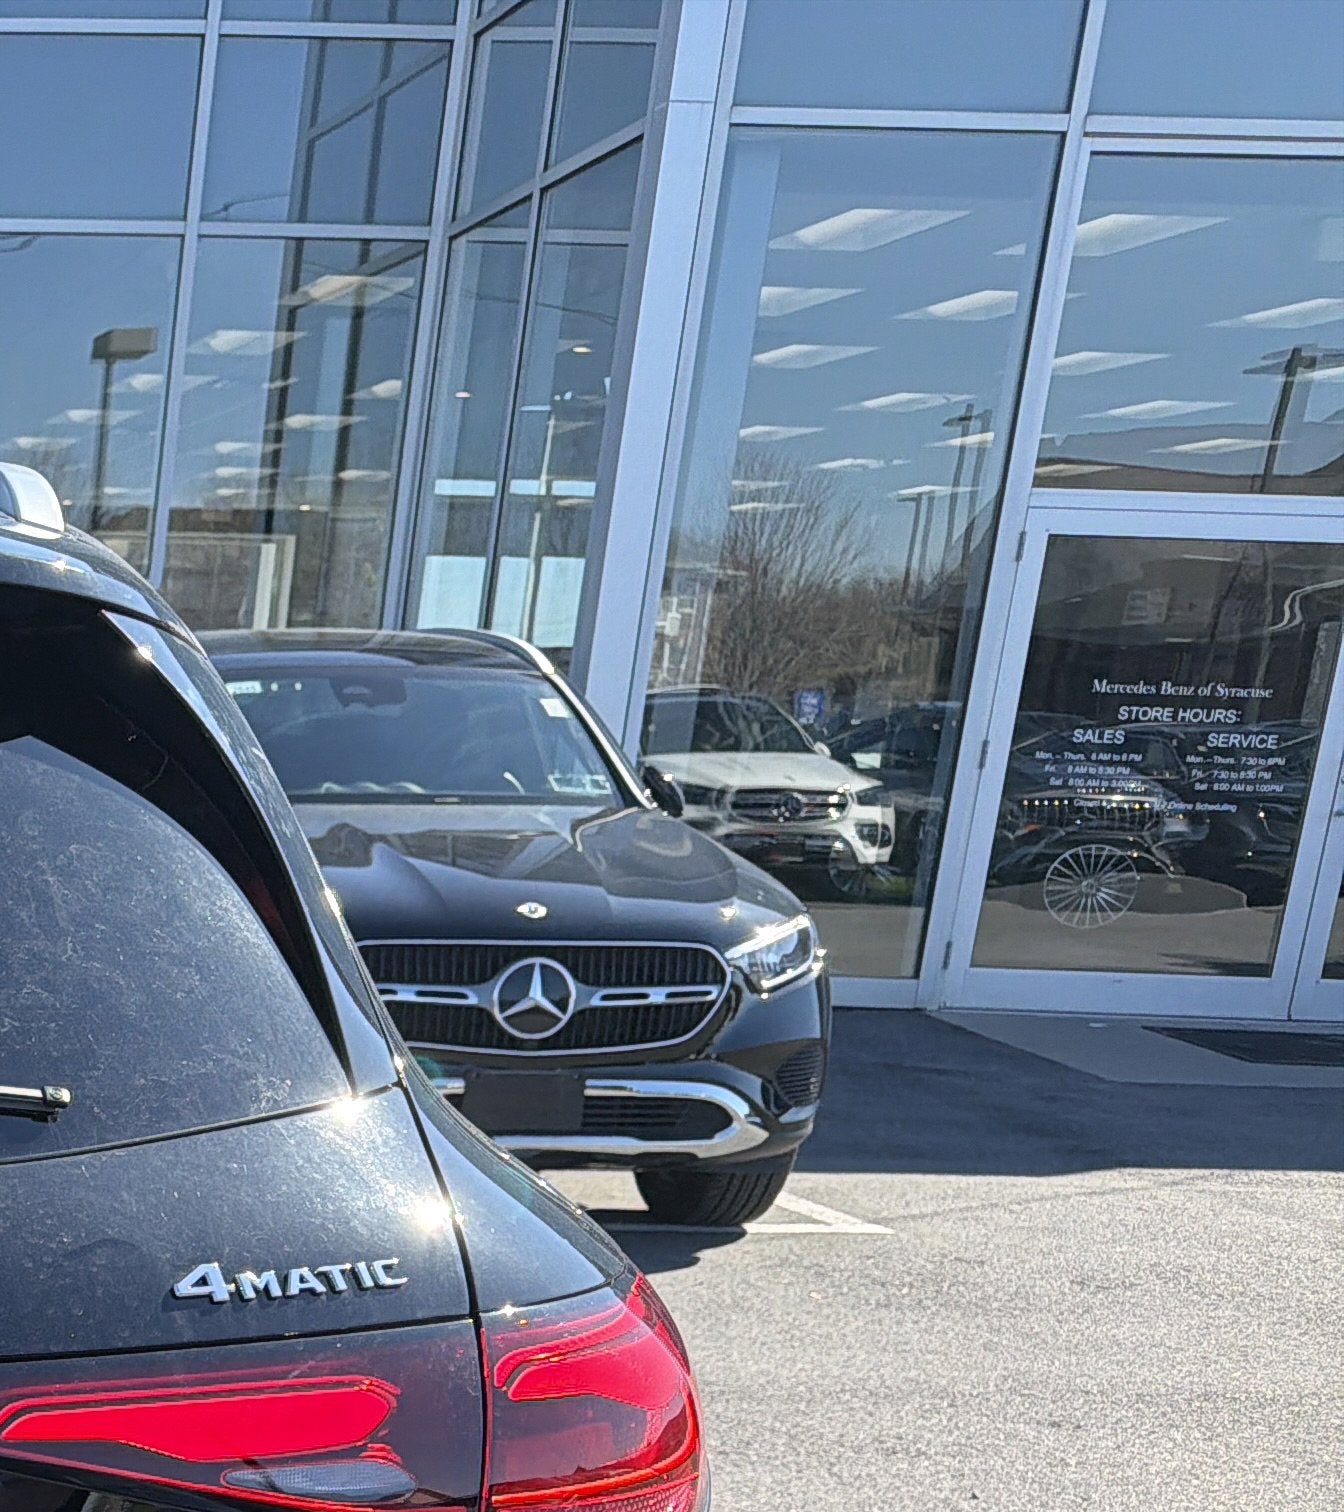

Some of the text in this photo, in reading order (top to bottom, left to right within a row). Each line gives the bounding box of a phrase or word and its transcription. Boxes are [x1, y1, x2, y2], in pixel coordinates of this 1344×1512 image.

[1091, 679, 1274, 700] Mercedes Benz of Syracuse
[1117, 705, 1243, 724] STORE HOURS:
[1072, 728, 1126, 745] SALES
[1206, 732, 1280, 750] SERVICE
[1128, 753, 1143, 762] PM
[1073, 765, 1088, 774] AM
[1116, 766, 1131, 775] PM
[1257, 772, 1272, 780] PM
[1085, 778, 1100, 787] AM
[1230, 783, 1245, 792] AM
[172, 1256, 409, 1302] 4MATIC
